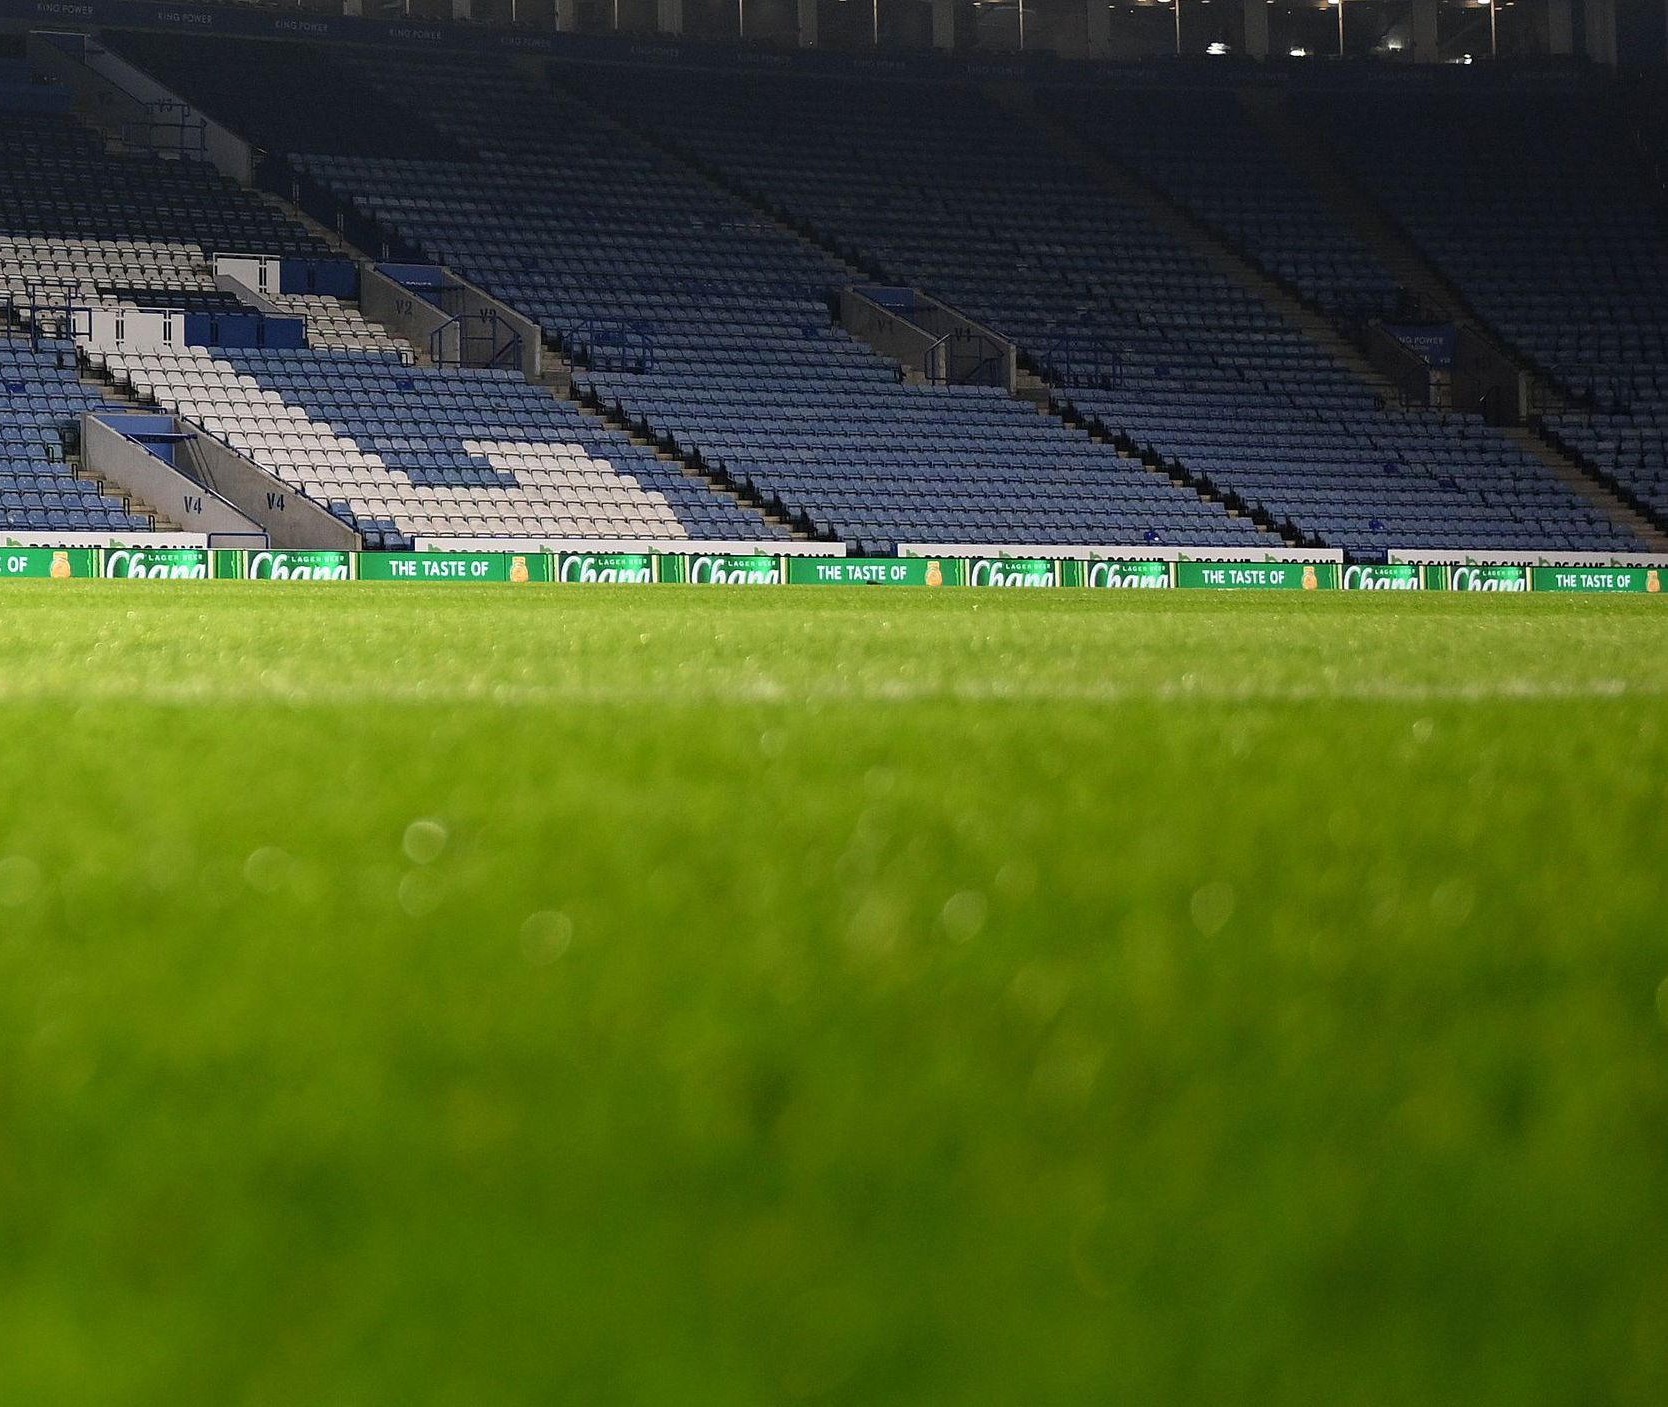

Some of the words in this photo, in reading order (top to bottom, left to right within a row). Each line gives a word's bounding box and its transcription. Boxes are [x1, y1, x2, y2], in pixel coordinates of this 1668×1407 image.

[37, 3, 60, 14] KING
[62, 4, 95, 15] POWER
[157, 12, 181, 22] KING
[182, 13, 213, 24] POWER
[184, 495, 202, 515] V4
[266, 492, 285, 512] V4
[7, 556, 28, 573] OF
[389, 560, 417, 577] THE
[422, 560, 466, 577] TASTE
[471, 560, 489, 577] OF
[816, 565, 842, 580] THE
[846, 565, 888, 580] TASTE
[891, 565, 907, 580] OF
[1202, 570, 1225, 584] THE
[1229, 570, 1266, 585] TASTE
[1269, 570, 1285, 584] OF
[1555, 574, 1577, 588] THE
[1580, 575, 1614, 588] TASTE
[1616, 575, 1632, 588] OF
